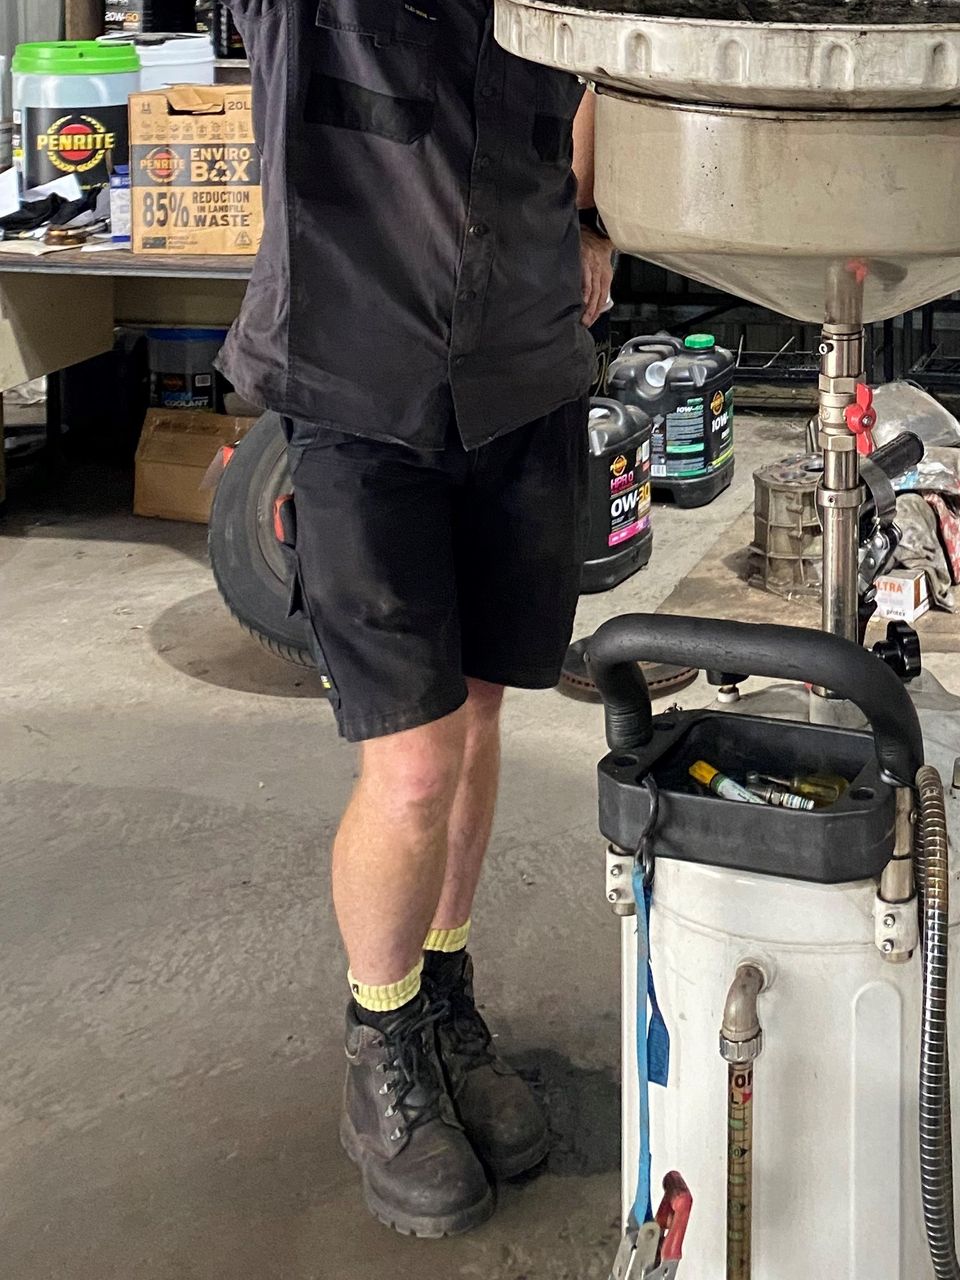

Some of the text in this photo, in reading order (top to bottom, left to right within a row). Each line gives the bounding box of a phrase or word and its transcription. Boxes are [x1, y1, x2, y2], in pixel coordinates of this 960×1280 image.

[104, 11, 139, 22] 20W-60
[227, 101, 251, 111] 20L
[36, 132, 115, 151] PENRITE
[190, 147, 250, 160] ENVIRO
[140, 159, 185, 170] PENRITE
[192, 191, 250, 204] REDUCTION
[142, 191, 190, 228] 85%
[197, 204, 245, 213] IN LANDFILL
[164, 399, 209, 408] COOLANT
[676, 404, 704, 414] 10W-40
[610, 473, 627, 490] HPR
[611, 481, 650, 518] 0W-30
